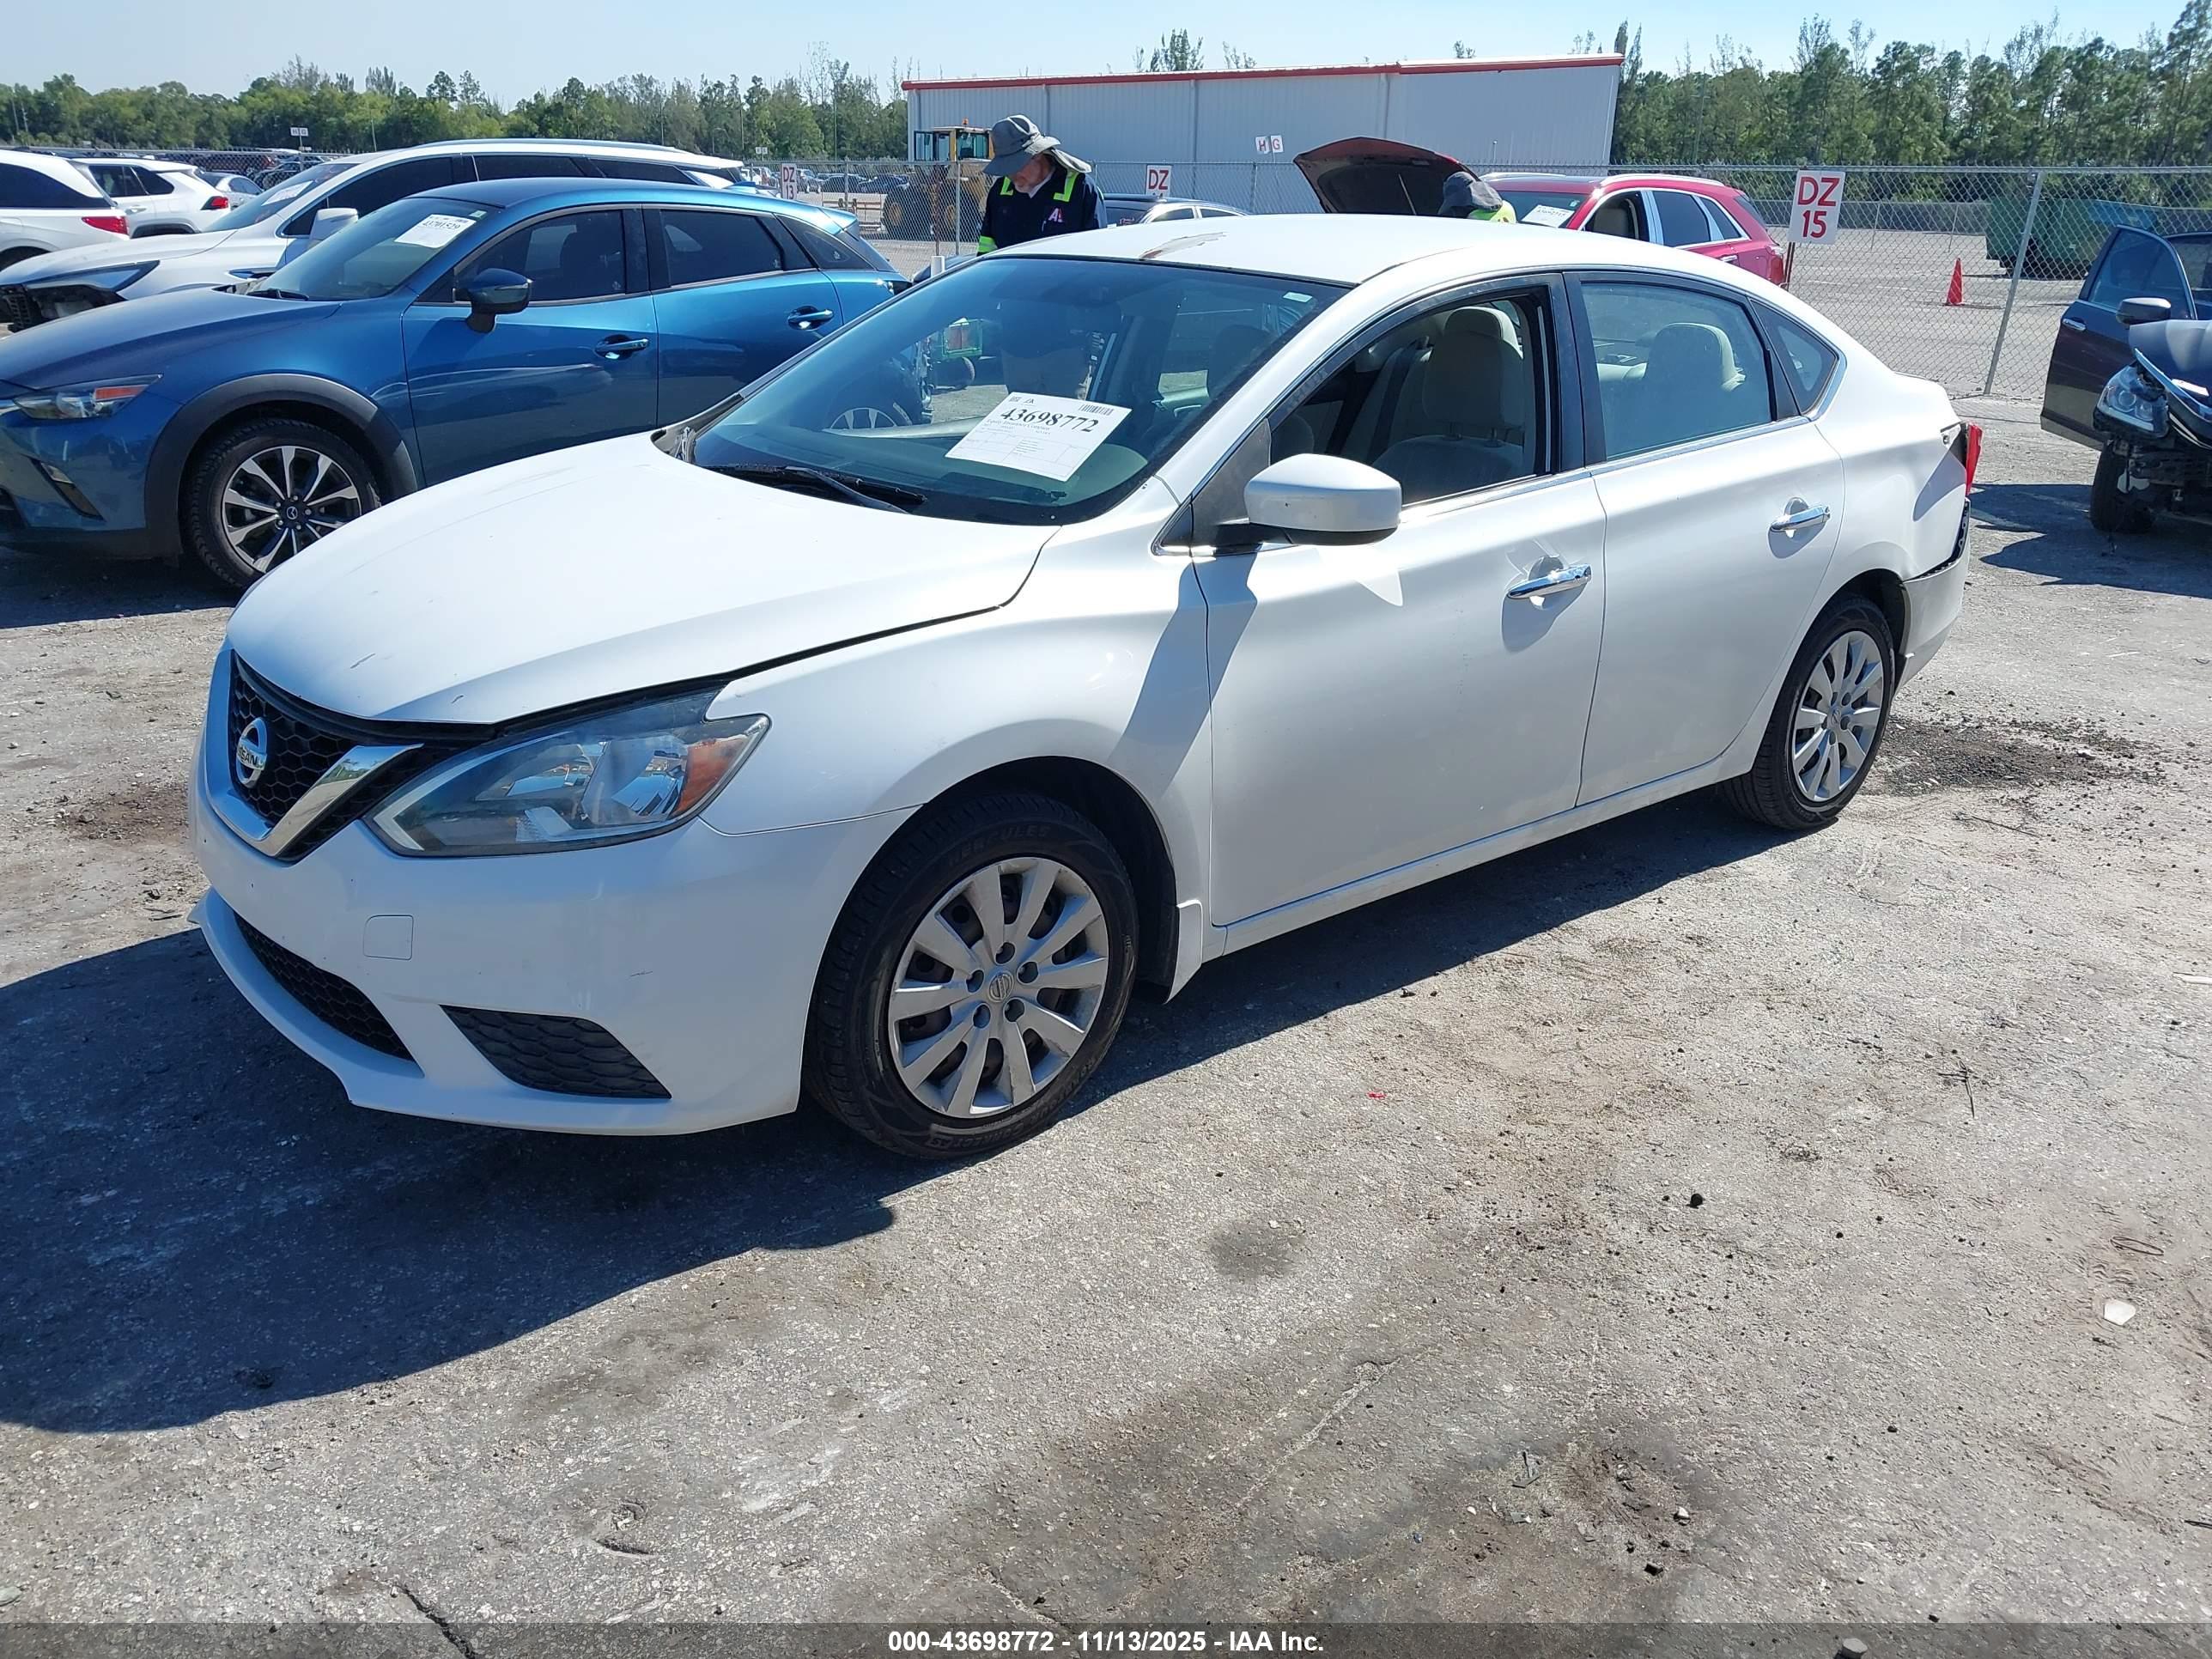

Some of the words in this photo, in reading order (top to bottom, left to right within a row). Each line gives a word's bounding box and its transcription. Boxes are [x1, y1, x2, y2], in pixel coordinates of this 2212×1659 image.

[1259, 140, 1267, 151] H
[1273, 138, 1280, 150] G
[783, 167, 795, 182] DZ
[1149, 169, 1169, 190] DZ
[787, 185, 794, 199] 13
[1798, 176, 1840, 206] DZ
[1802, 210, 1827, 238] 15
[1000, 408, 1099, 433] 43698772
